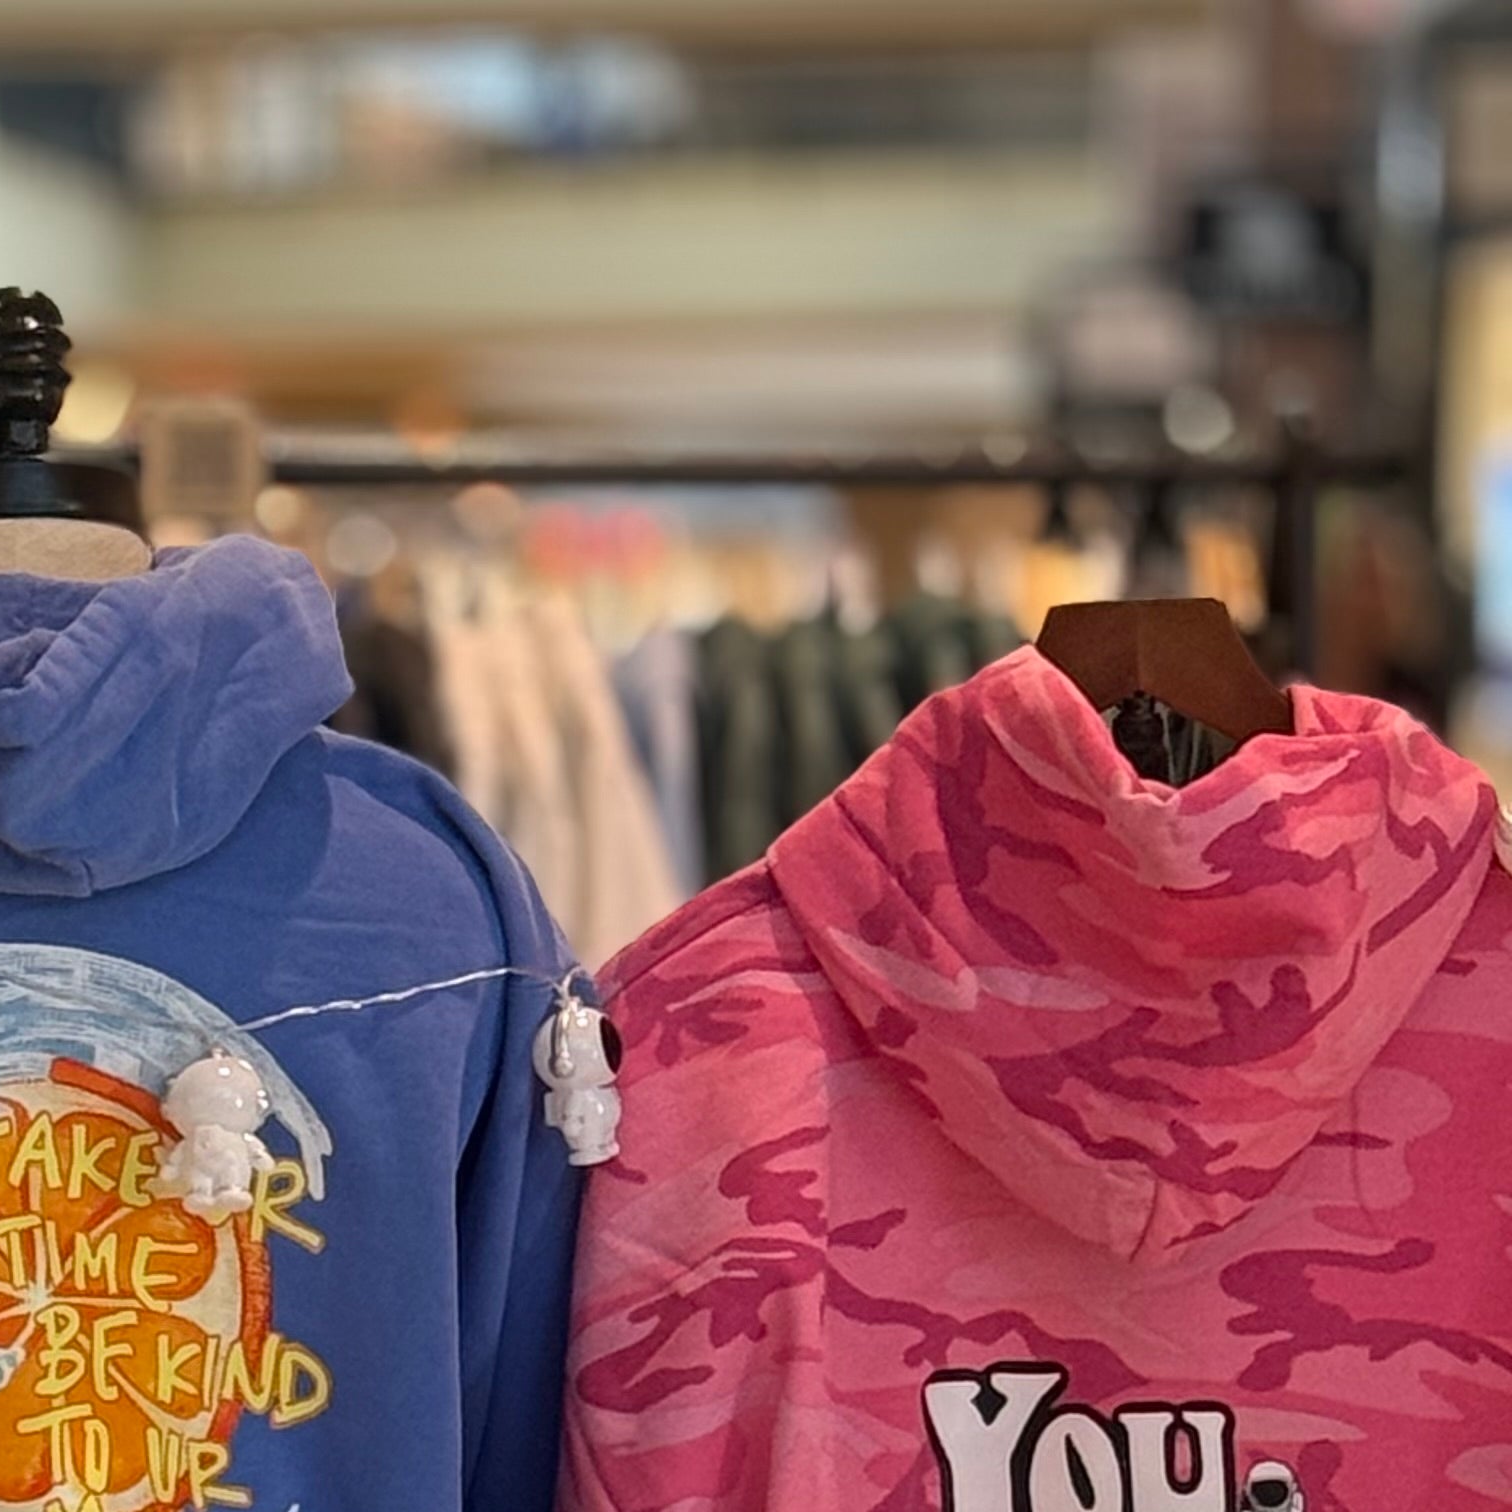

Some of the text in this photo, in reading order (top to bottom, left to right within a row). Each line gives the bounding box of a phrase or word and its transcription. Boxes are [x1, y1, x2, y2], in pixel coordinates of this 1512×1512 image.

[36, 1304, 330, 1428] BE KIND
[18, 1404, 252, 1509] TO UR
